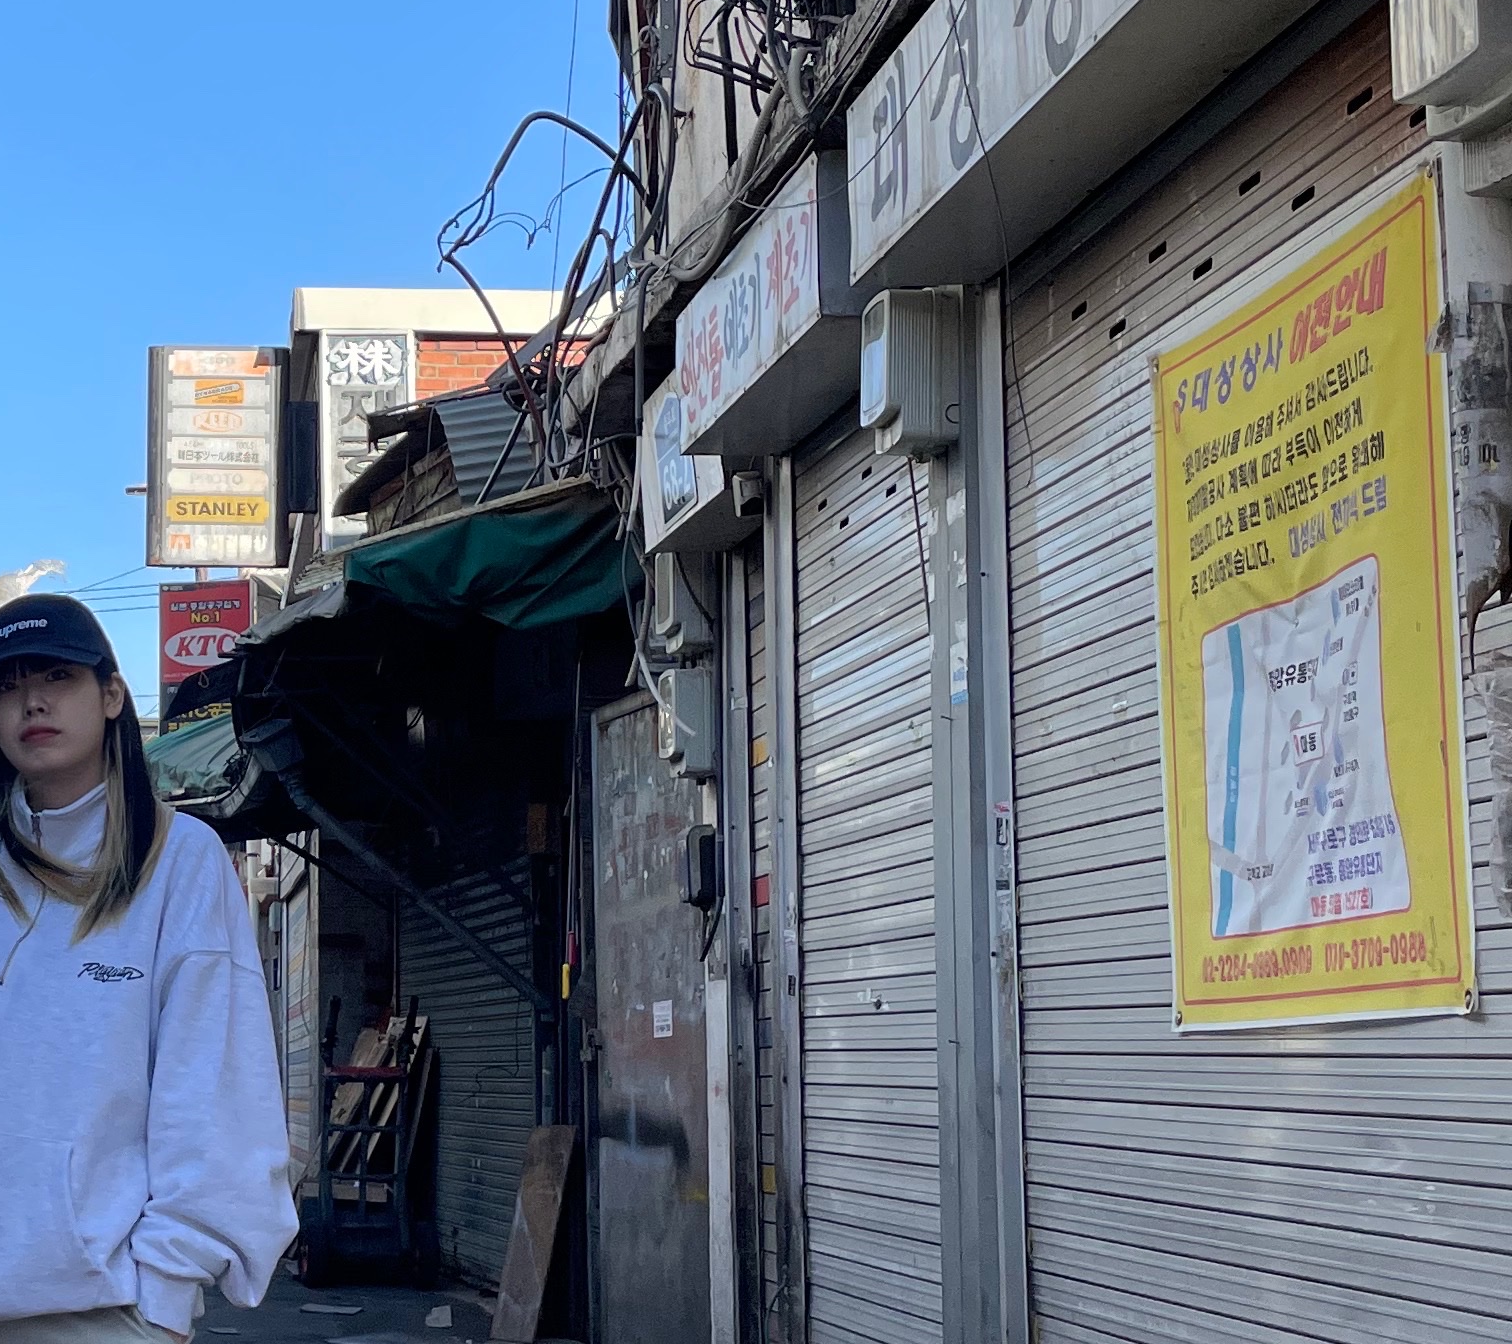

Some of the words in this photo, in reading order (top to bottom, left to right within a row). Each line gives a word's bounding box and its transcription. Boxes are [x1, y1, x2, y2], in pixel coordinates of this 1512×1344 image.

[1192, 327, 1283, 413] 대성상사
[1289, 246, 1388, 365] 이전안내
[1286, 425, 1322, 466] 부득이
[176, 501, 259, 516] STANLEY
[174, 633, 236, 657] KTC
